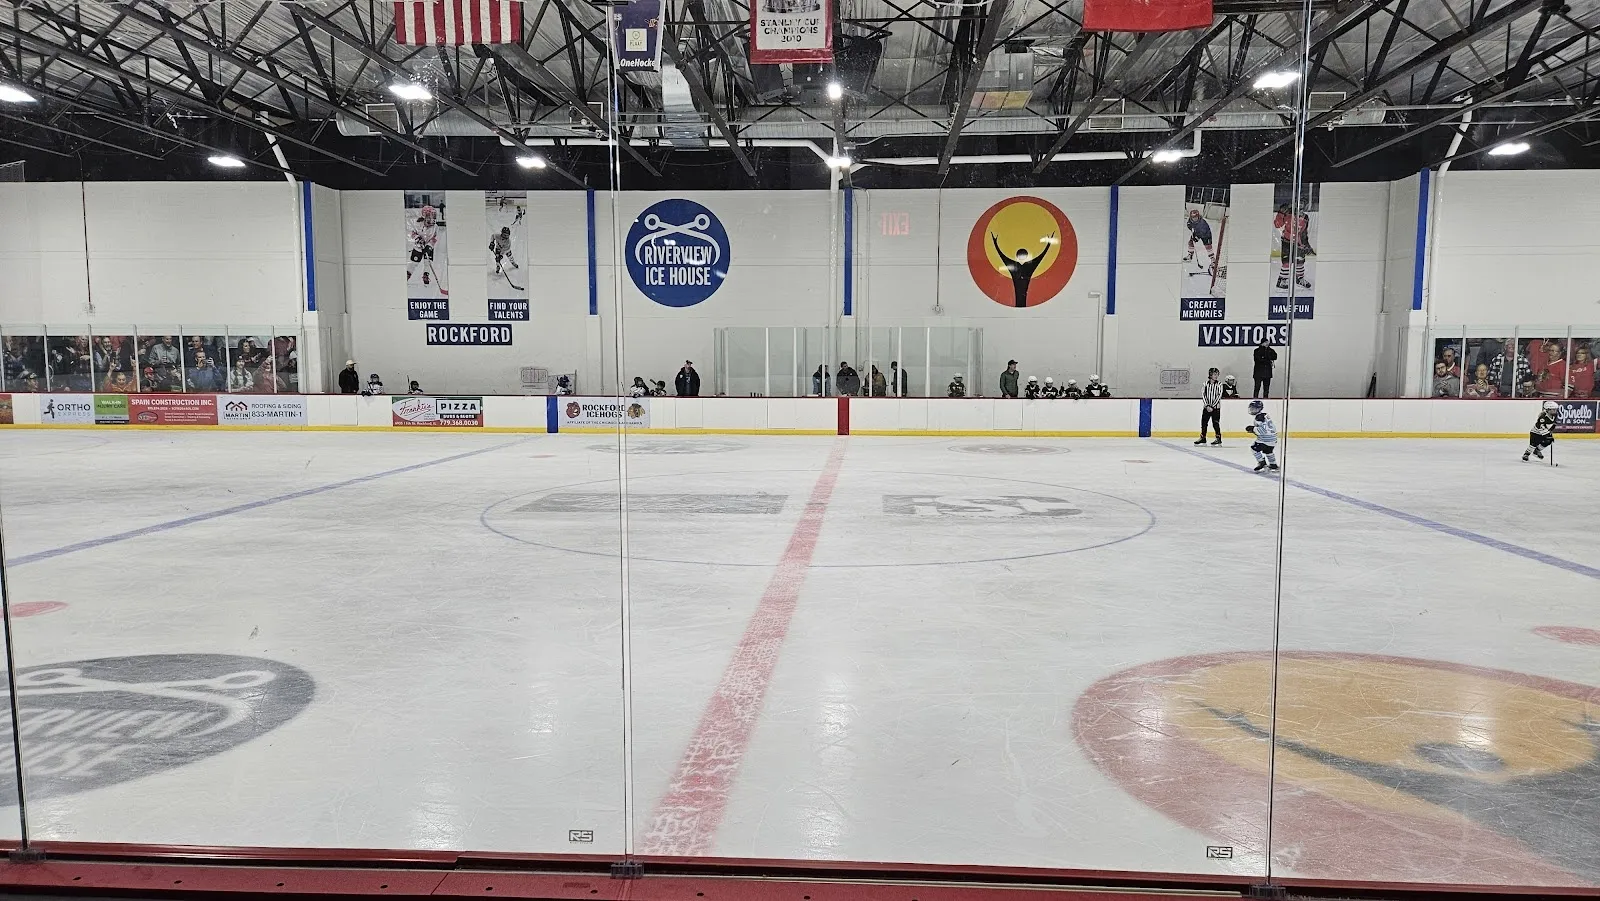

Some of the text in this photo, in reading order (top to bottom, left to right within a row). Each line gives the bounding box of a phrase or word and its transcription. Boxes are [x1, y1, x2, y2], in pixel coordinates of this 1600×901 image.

[764, 27, 818, 35] CHAMPIONS
[644, 245, 712, 265] RIVERVIEW
[645, 266, 711, 286] ICE HOUSE
[410, 302, 447, 310] ENJOY THE
[490, 302, 527, 310] FIND YOUR
[1188, 301, 1217, 309] CREATE
[1273, 304, 1310, 313] HAVE FUN
[419, 310, 439, 319] GAME
[493, 310, 524, 319] TALENTS
[1182, 309, 1223, 318] MEMORIES
[428, 325, 511, 344] ROCKFORD
[1202, 326, 1288, 345] VISITORS
[57, 403, 91, 411] ORTHO
[582, 404, 625, 412] ROCKFORD
[1557, 404, 1592, 423] Spinello
[568, 829, 594, 843] RS
[1206, 845, 1234, 859] RS
